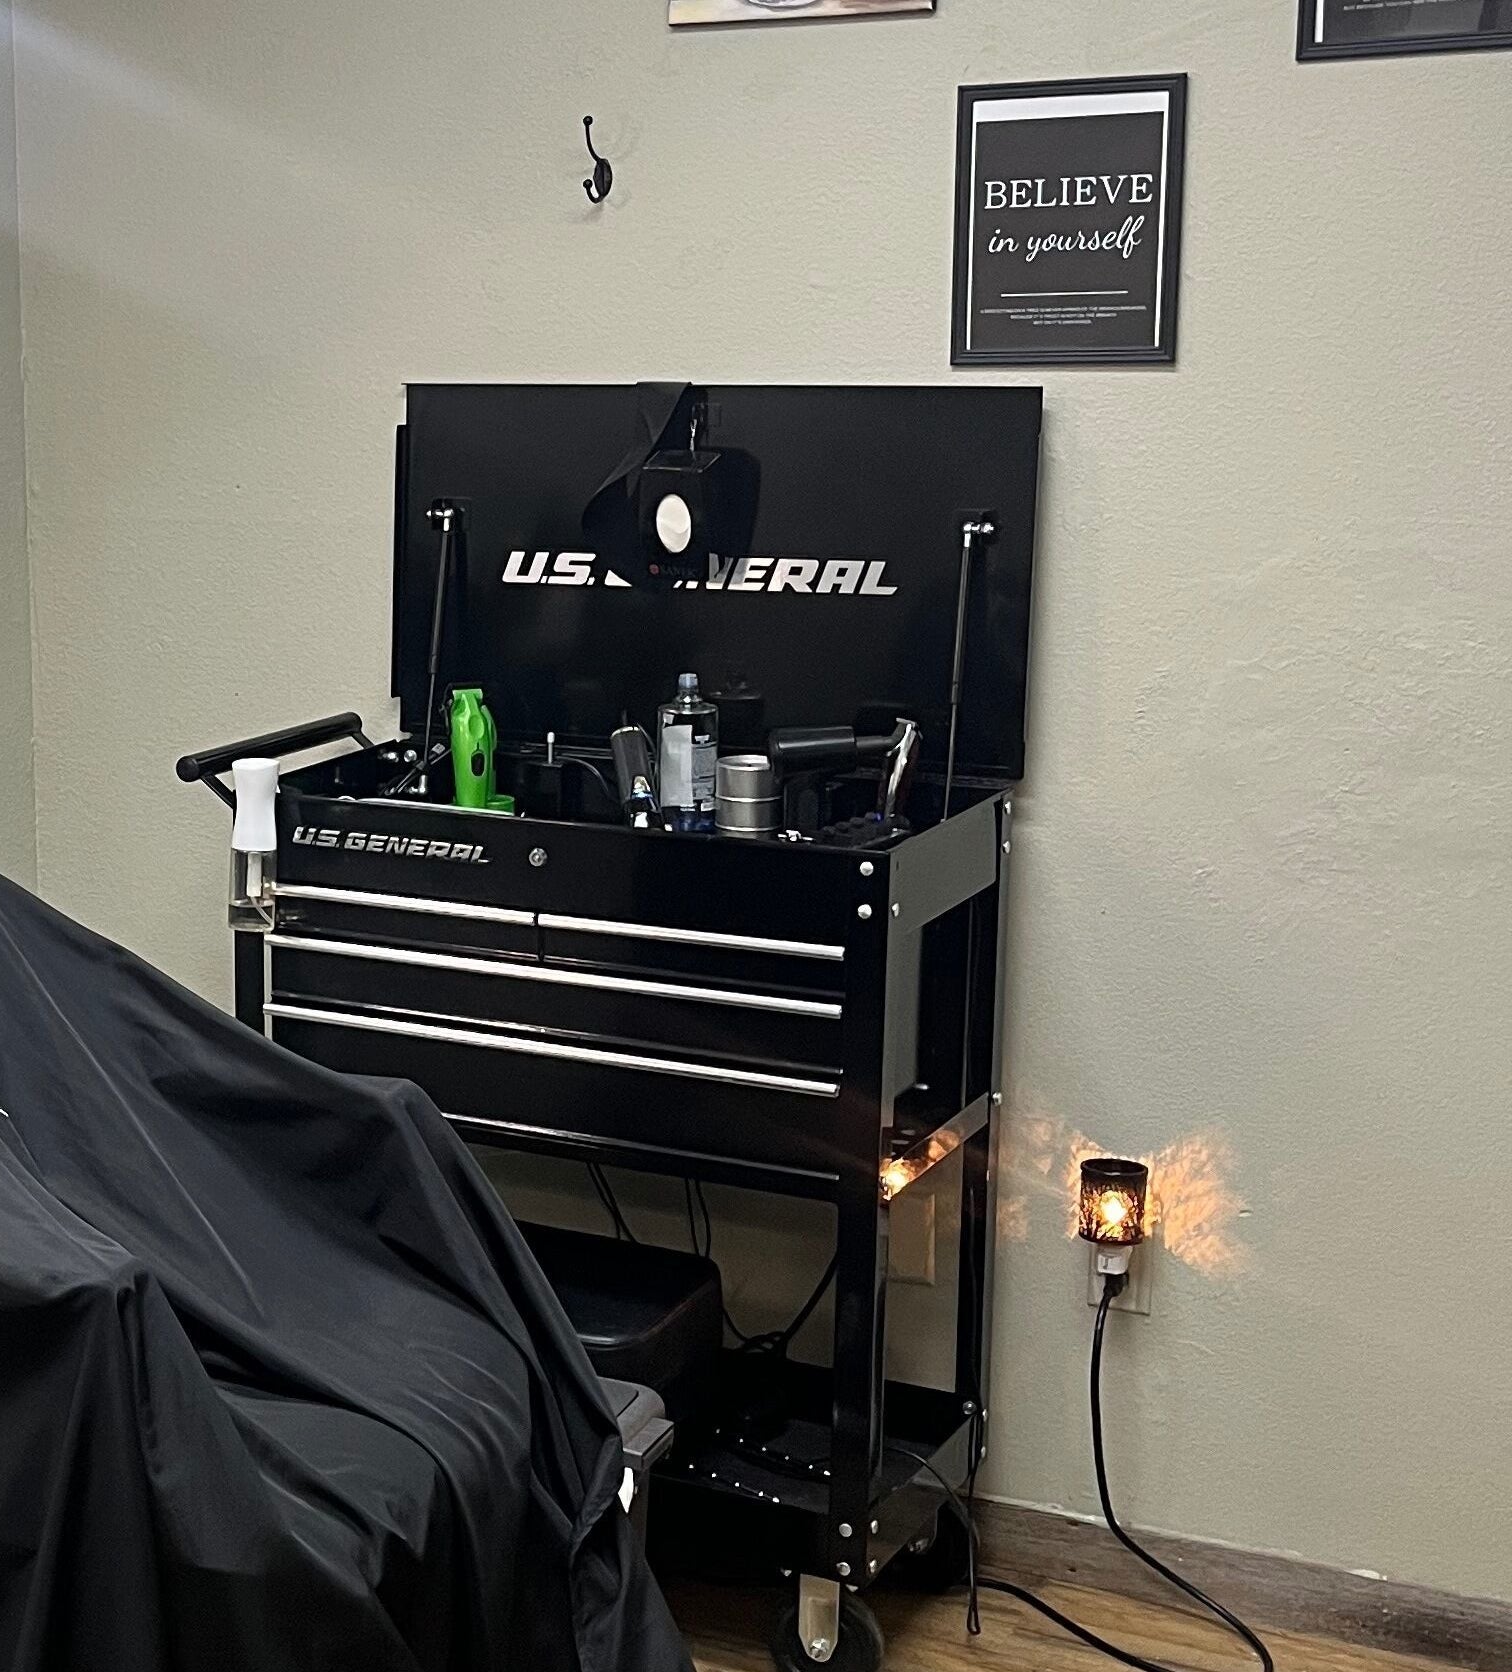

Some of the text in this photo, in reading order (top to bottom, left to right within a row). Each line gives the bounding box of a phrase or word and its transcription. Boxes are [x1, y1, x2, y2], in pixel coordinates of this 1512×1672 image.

[984, 173, 1153, 210] BELIEVE
[988, 215, 1145, 262] in yourself
[501, 550, 597, 586] U.S.
[292, 826, 491, 863] U.S. GENERAL
